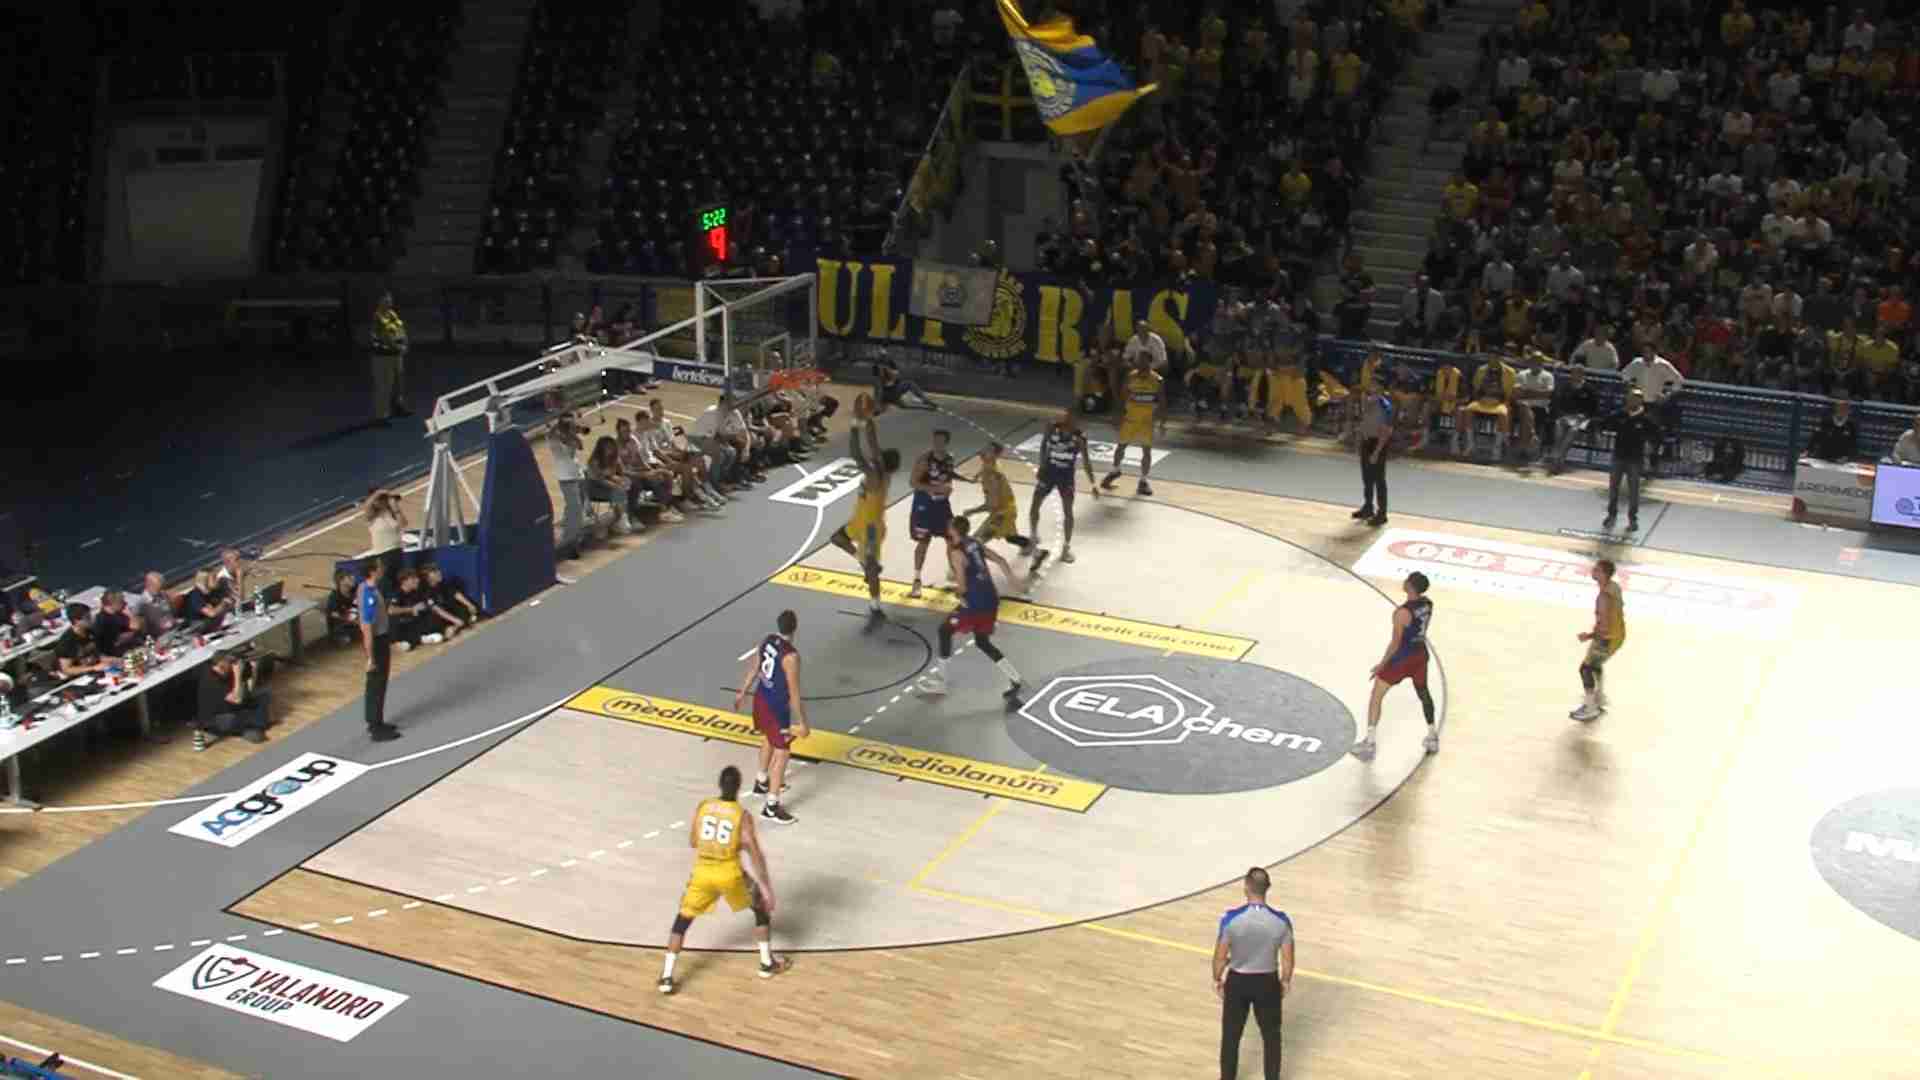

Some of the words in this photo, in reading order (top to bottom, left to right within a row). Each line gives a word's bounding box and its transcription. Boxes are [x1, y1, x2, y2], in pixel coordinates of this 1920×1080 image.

[612, 699, 763, 737] mediolan
[1064, 690, 1165, 725] ELA
[1182, 716, 1323, 752] chem
[856, 748, 1060, 796] mediolanum
[700, 815, 734, 844] 66
[225, 988, 295, 1014] GROUP
[249, 970, 385, 1020] VALANDRO
